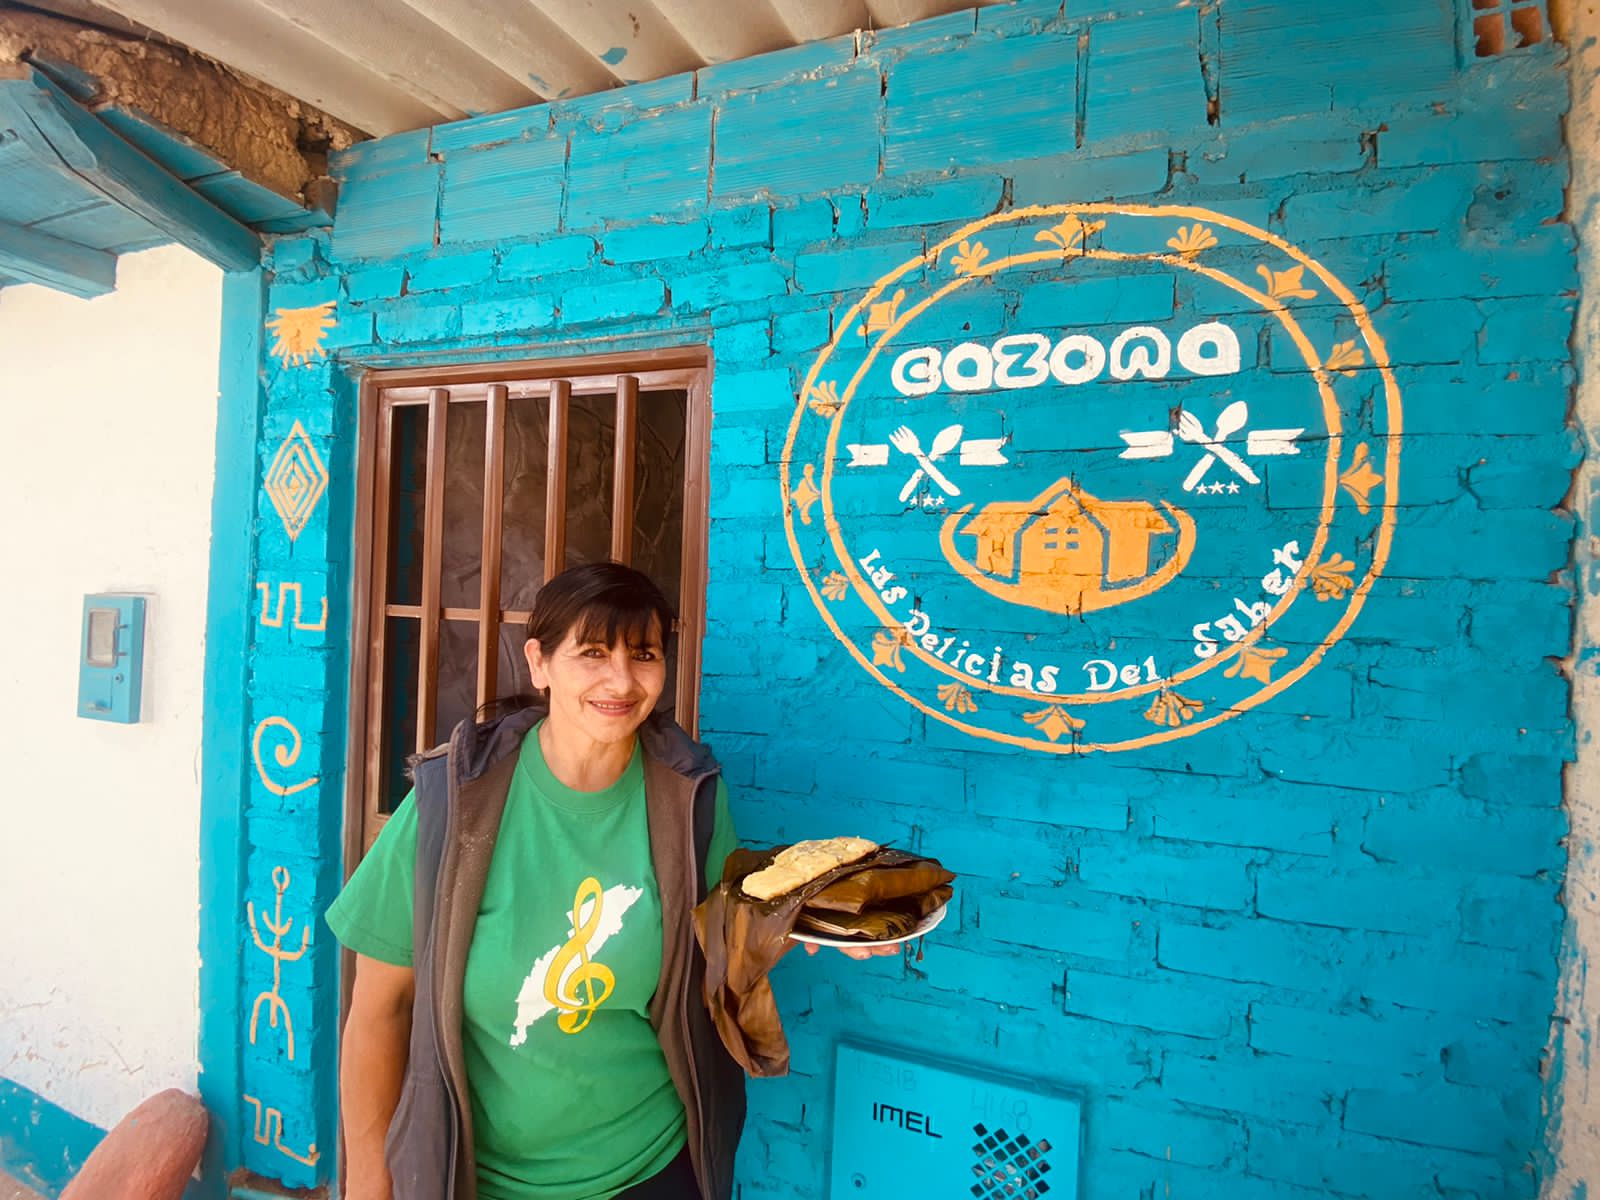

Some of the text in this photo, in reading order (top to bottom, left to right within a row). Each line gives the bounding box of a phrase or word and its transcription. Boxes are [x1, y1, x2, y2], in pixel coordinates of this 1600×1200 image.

[858, 540, 1303, 692] Las Delicias Del Saber
[873, 1102, 943, 1140] IMEL
